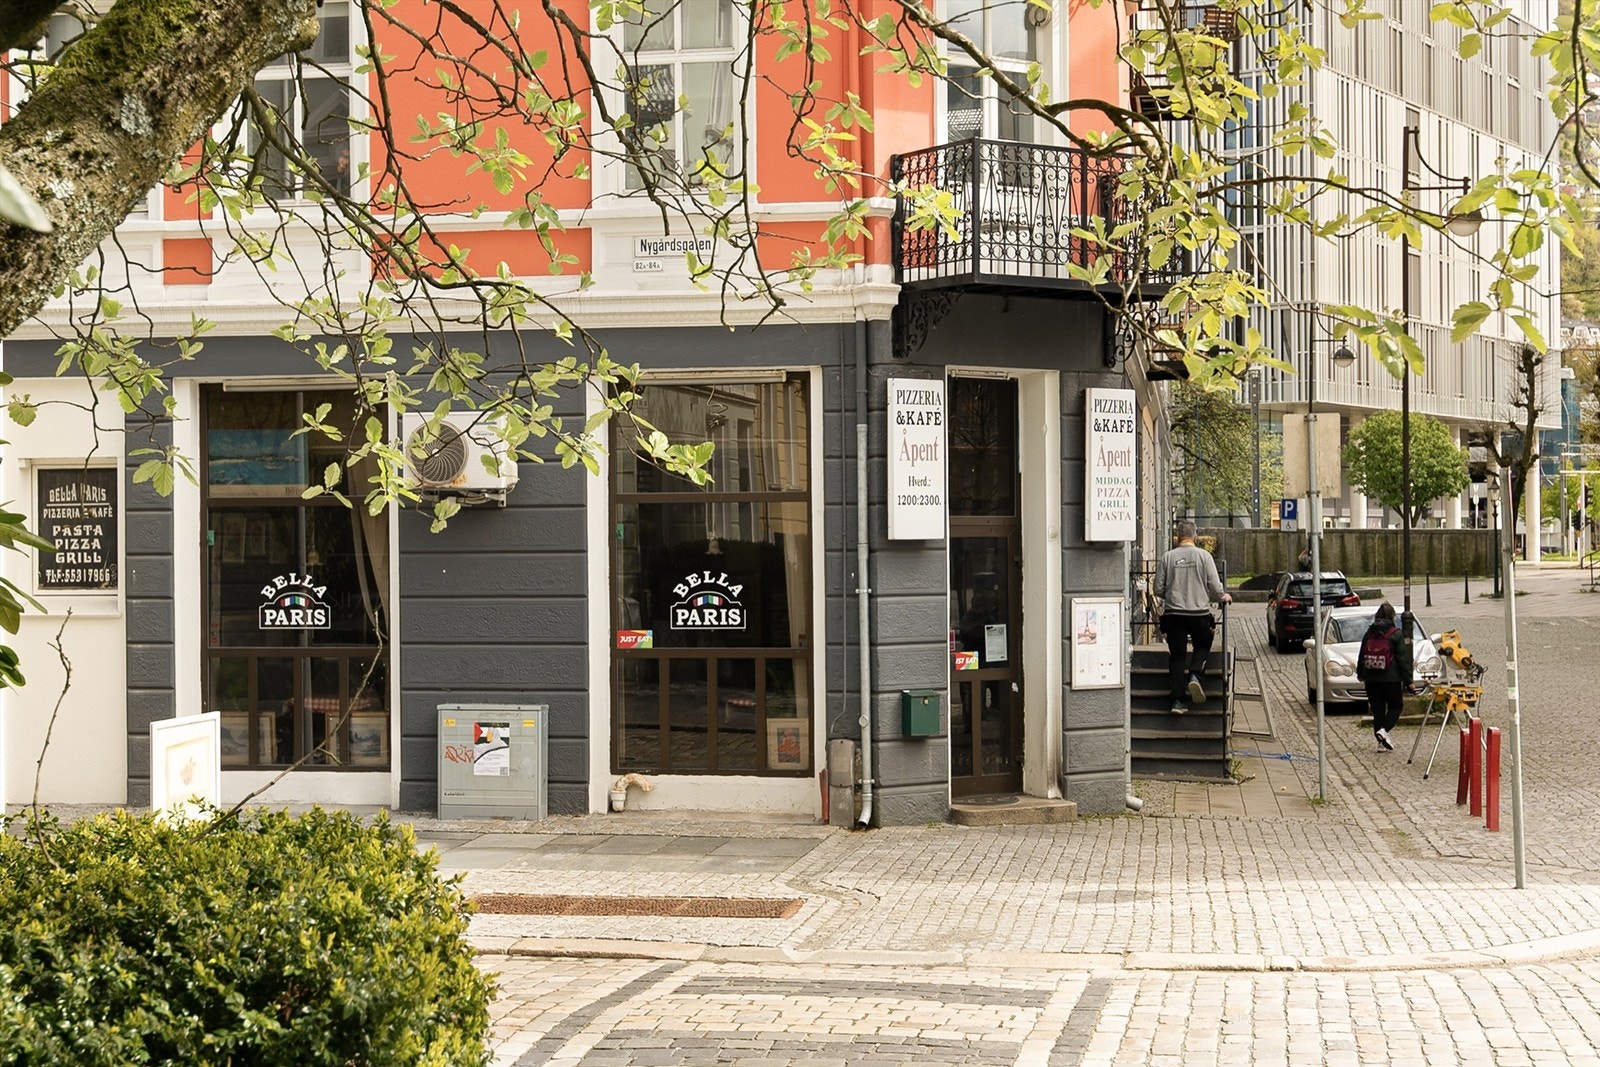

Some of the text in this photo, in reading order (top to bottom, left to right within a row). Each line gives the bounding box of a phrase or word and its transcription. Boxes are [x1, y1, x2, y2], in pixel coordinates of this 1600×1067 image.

[640, 239, 711, 255] Nygårdsgaen
[896, 389, 942, 406] PIZZERIA
[1094, 398, 1134, 414] PIZZERIA
[899, 428, 939, 467] Åpent
[1096, 435, 1132, 472] Åpent
[1095, 476, 1132, 485] MIDDAG
[49, 482, 77, 502] BELLA
[1097, 487, 1130, 498] PIZZA
[1099, 500, 1129, 508] GRILL
[1284, 501, 1294, 517] P
[43, 508, 80, 519] PIZZERIA
[1097, 511, 1132, 521] PASTA
[52, 525, 103, 536] PASTA
[55, 539, 101, 550] PIZZA
[55, 552, 102, 564] GRILL
[260, 572, 327, 599] BELLA
[673, 571, 743, 597] BELLA
[264, 609, 326, 625] PARIS
[676, 608, 741, 625] PARIS
[620, 635, 636, 643] JUST
